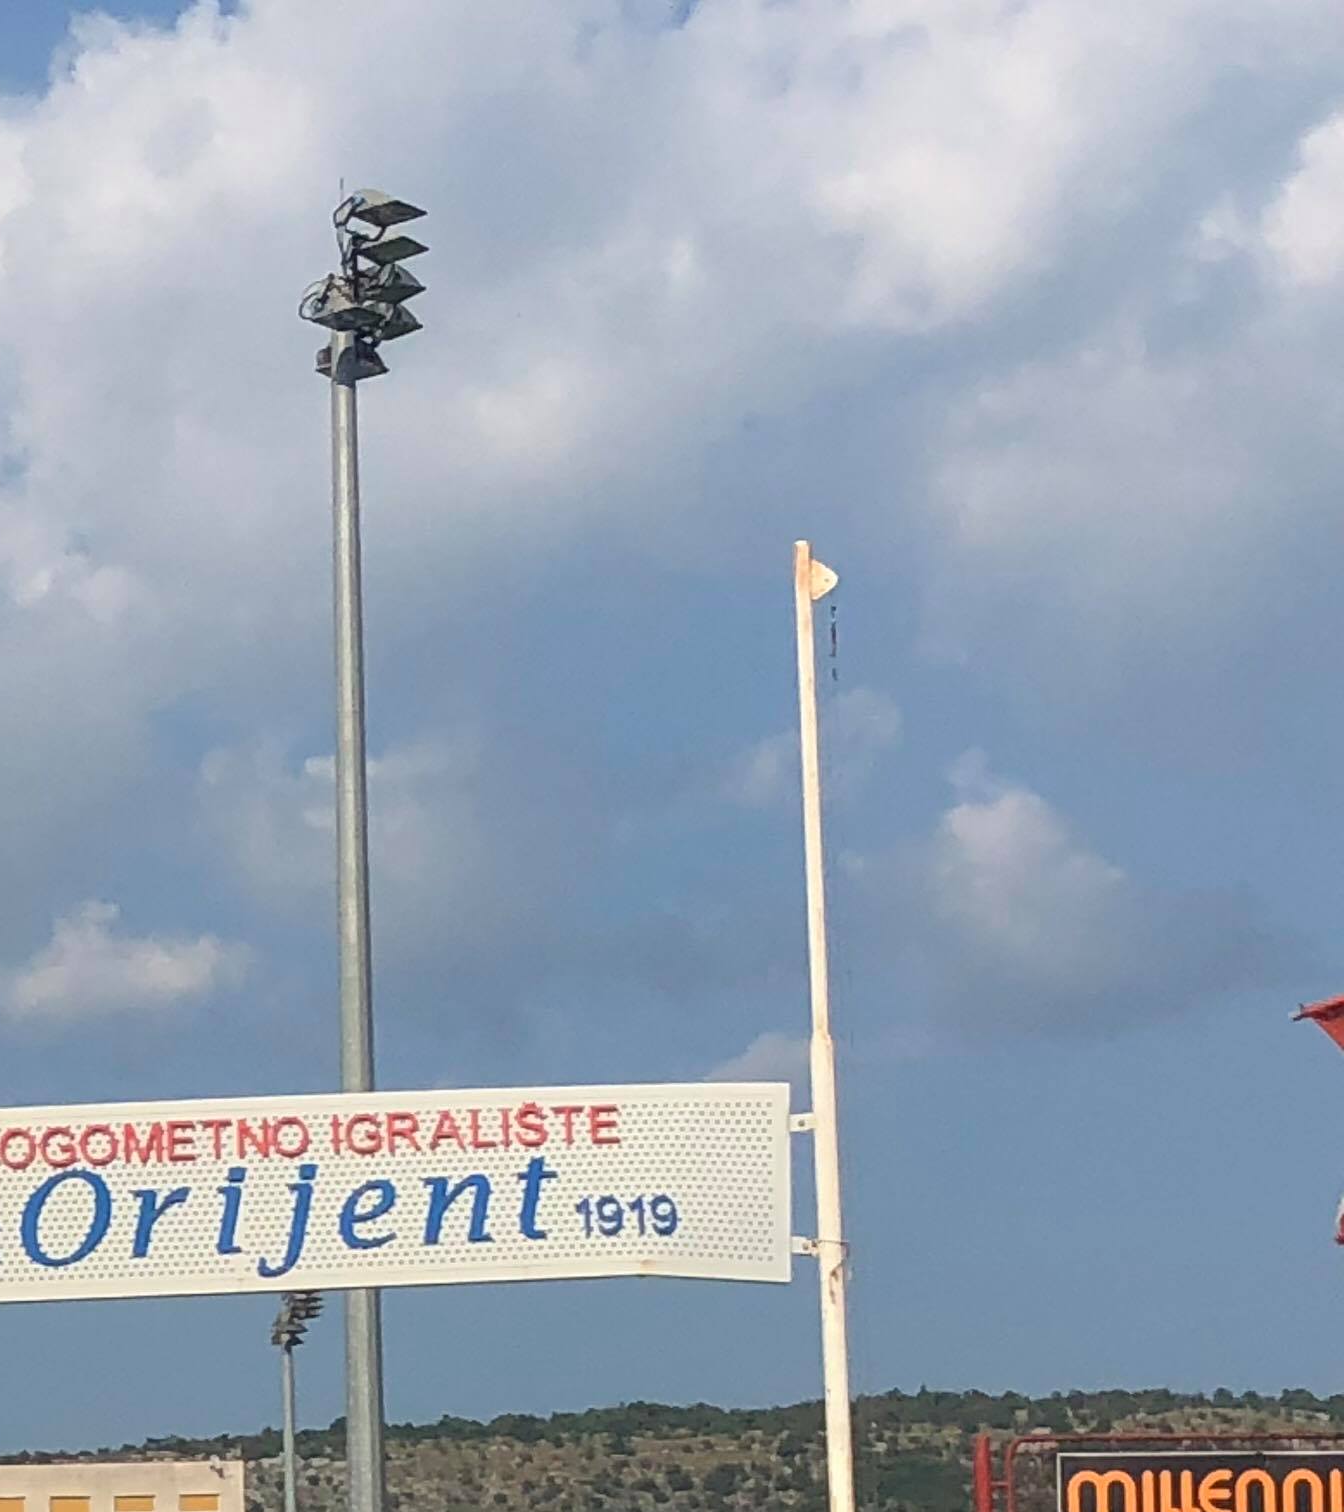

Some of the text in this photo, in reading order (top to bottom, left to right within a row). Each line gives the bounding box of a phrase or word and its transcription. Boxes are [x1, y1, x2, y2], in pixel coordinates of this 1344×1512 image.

[331, 1102, 621, 1156] IGRALIŠTE
[19, 1156, 559, 1278] Orijent
[574, 1193, 681, 1239] 1919
